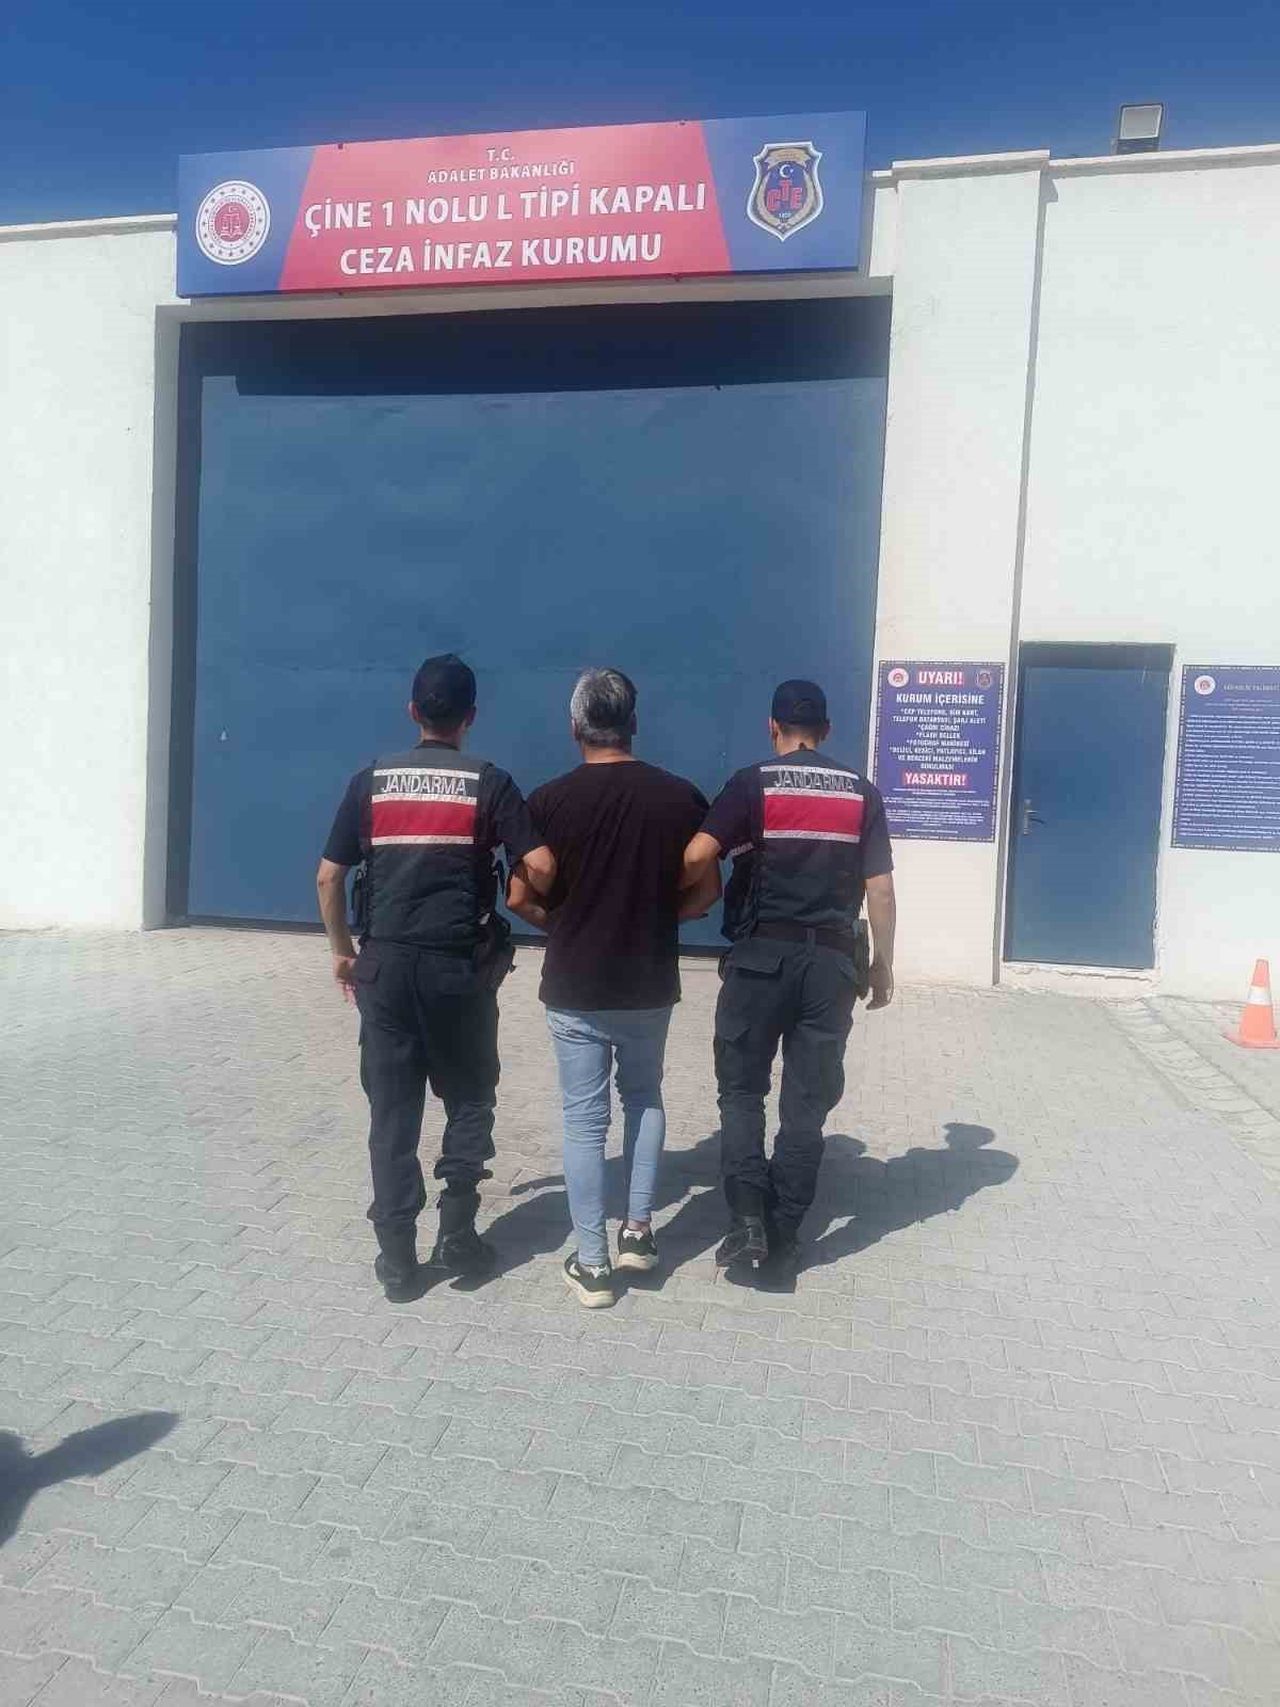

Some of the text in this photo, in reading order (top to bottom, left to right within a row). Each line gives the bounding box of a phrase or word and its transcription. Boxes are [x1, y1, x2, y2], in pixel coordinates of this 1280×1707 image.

[487, 148, 515, 162] T.C.
[428, 160, 575, 184] ADALET BAKANLIĞI
[305, 182, 706, 238] ÇİNE 1 NOLU L TİPİ KAPALI
[340, 233, 662, 275] CEZA İNFAZ KURUMU
[918, 671, 964, 686] UYARI!
[896, 692, 986, 707] KURUM İÇERİSİNE
[381, 774, 472, 796] JANDARMA
[774, 770, 854, 794] JANDARMA
[905, 772, 966, 787] YASAKTIR!
